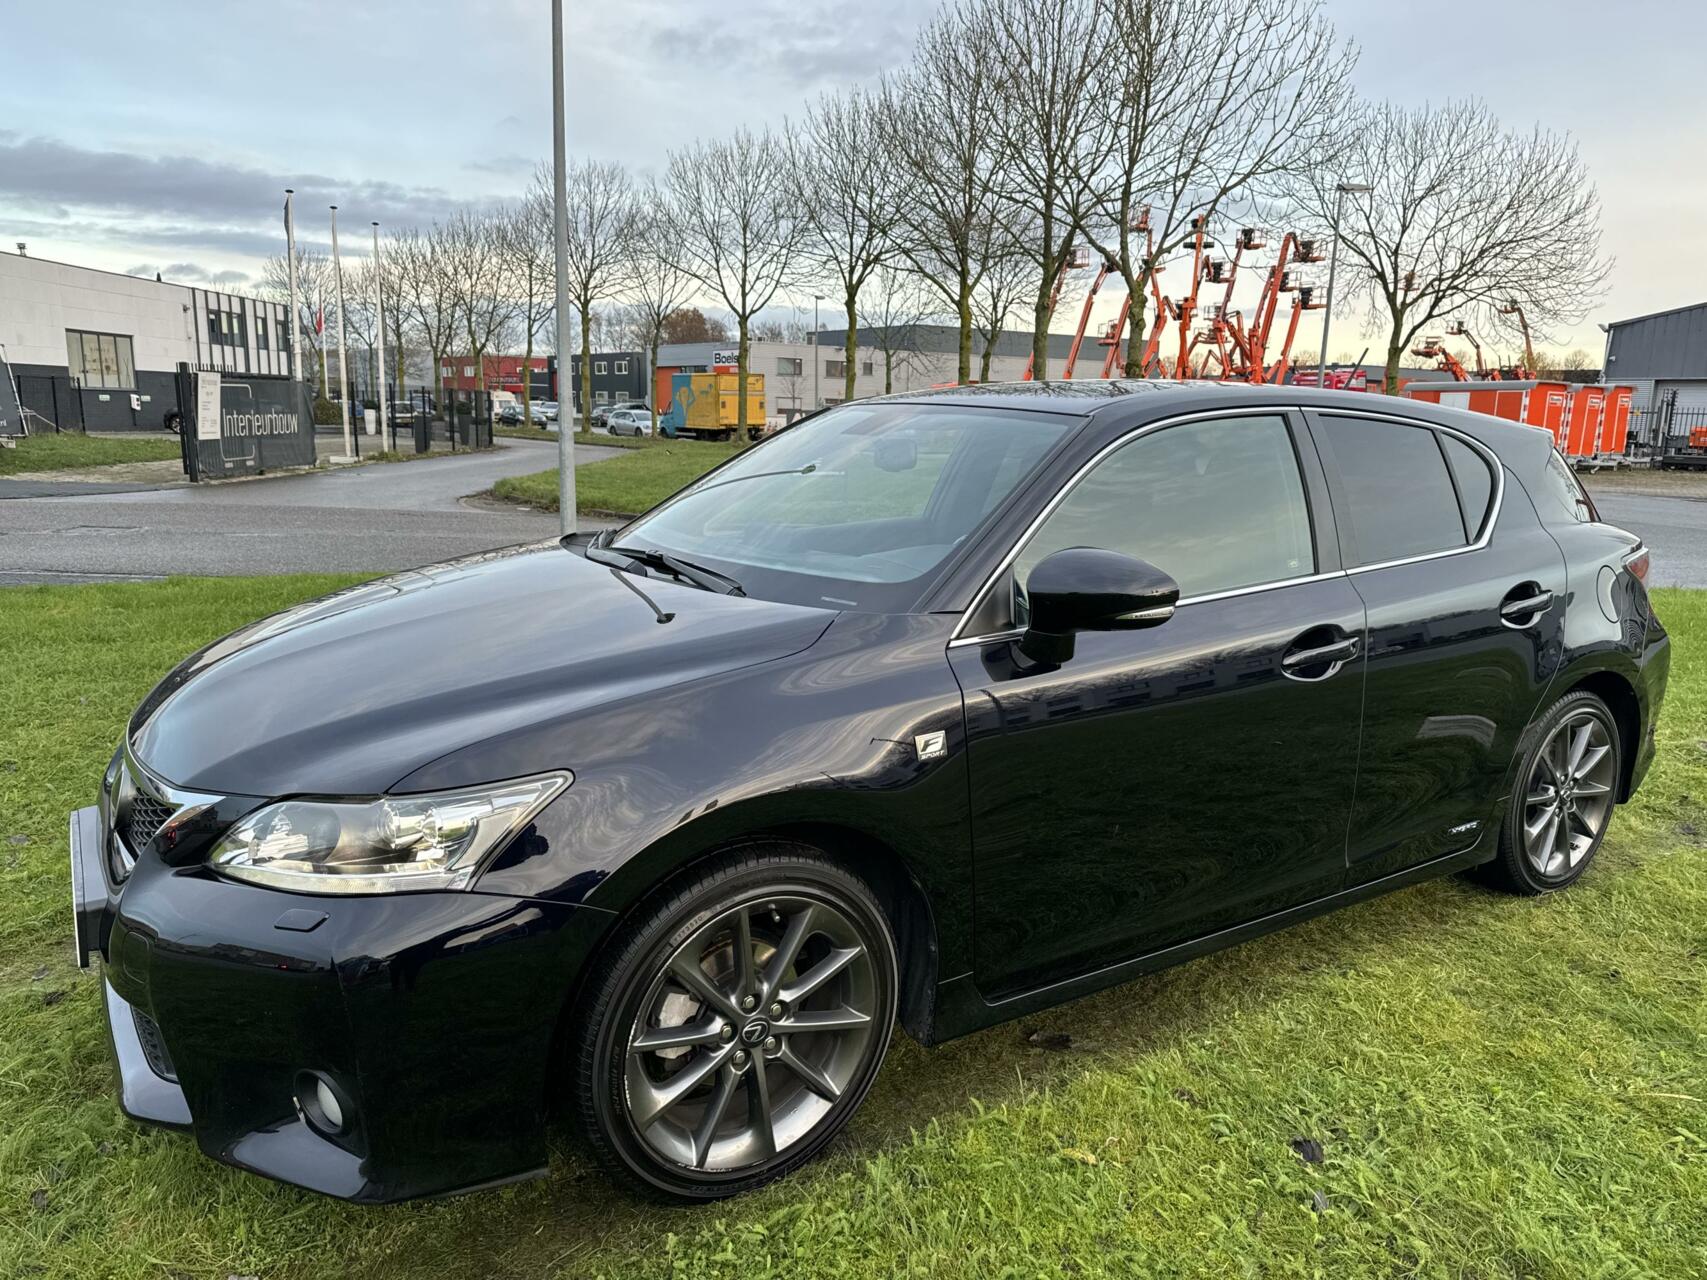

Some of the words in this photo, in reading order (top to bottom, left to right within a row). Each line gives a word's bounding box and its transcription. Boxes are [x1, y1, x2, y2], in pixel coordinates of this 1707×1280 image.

[714, 351, 739, 364] Boels
[222, 407, 298, 438] Interieurbouw
[920, 750, 945, 761] SPORT
